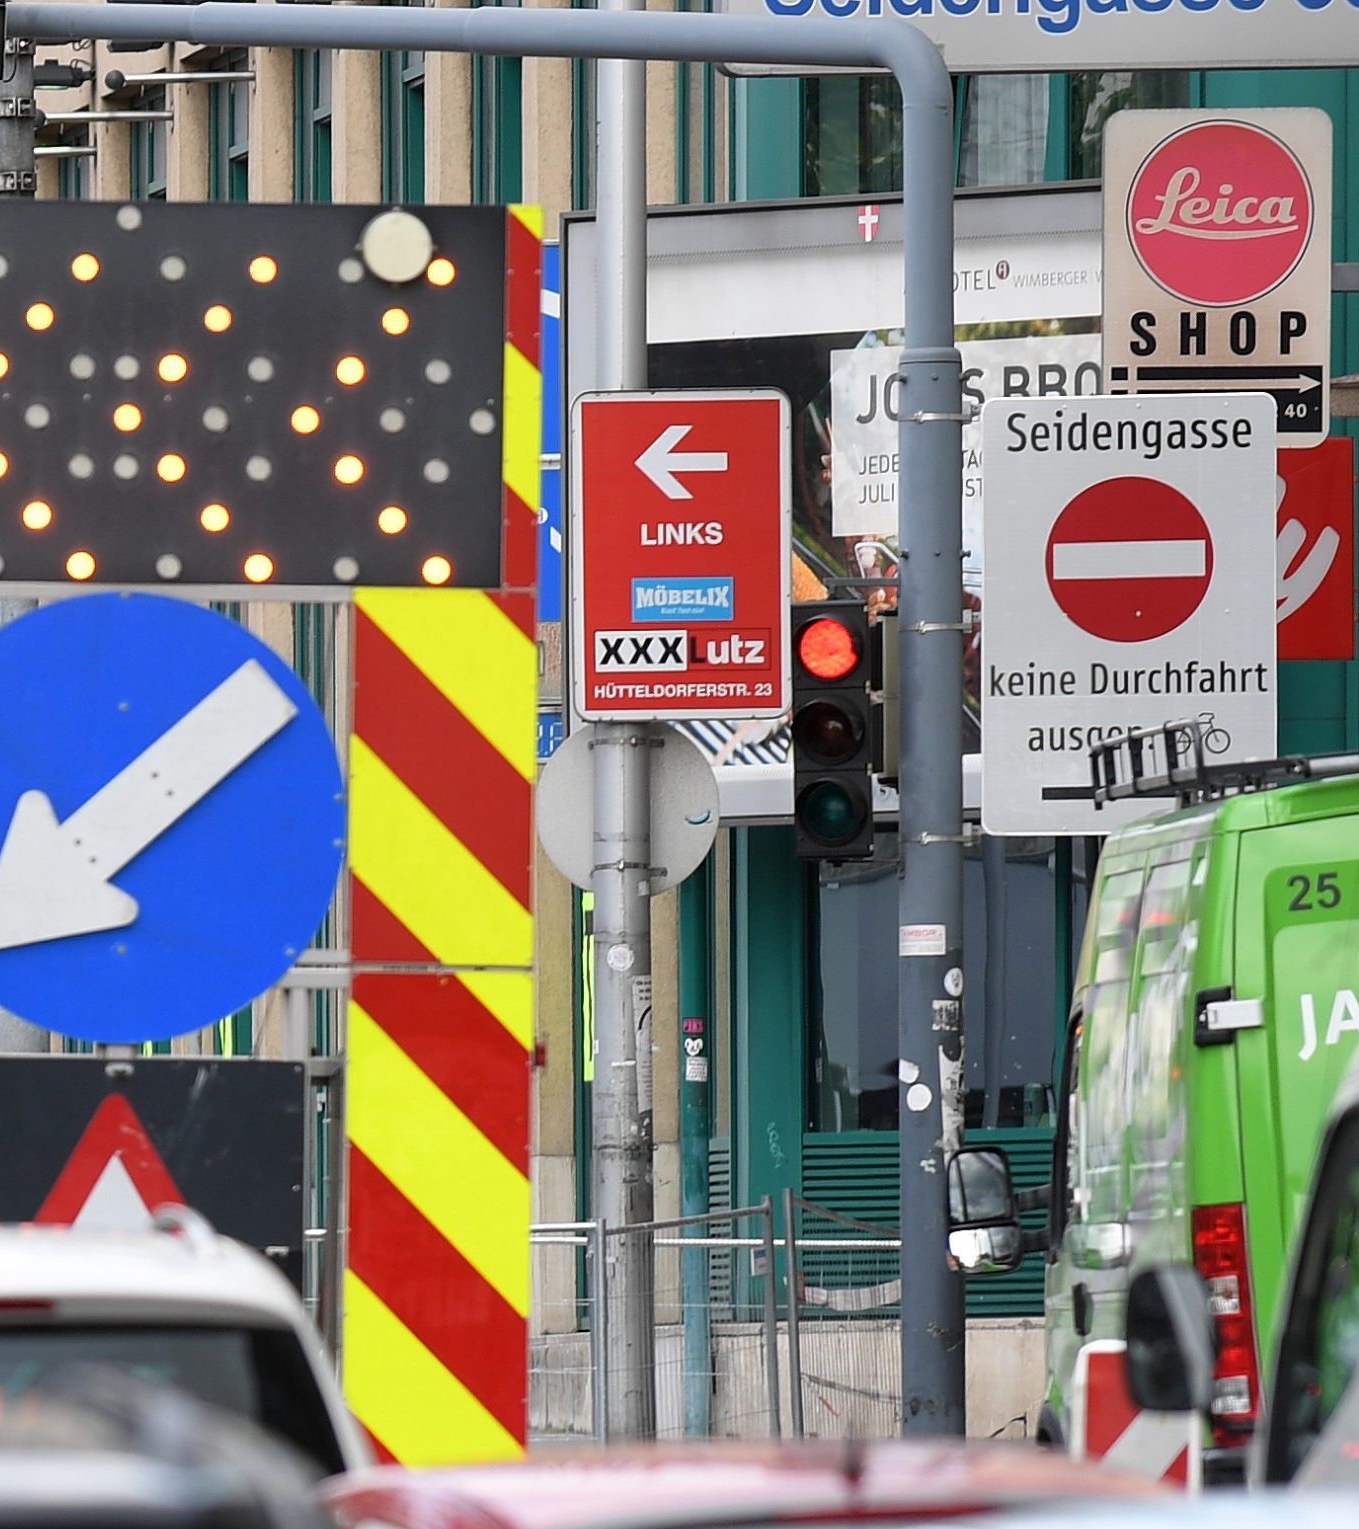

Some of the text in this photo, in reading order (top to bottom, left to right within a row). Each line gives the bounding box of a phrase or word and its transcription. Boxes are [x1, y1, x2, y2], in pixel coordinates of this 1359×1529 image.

[1135, 165, 1300, 240] Leica
[1130, 311, 1308, 357] SHOP
[1284, 403, 1308, 419] 40
[1006, 412, 1253, 459] Seidengasse
[640, 522, 723, 546] LINKS
[636, 584, 729, 608] MÖBELIX
[594, 682, 773, 699] HÜTTELDORFERSTR. 23
[990, 660, 1269, 697] keine Durchfahrt
[1288, 871, 1341, 911] 25
